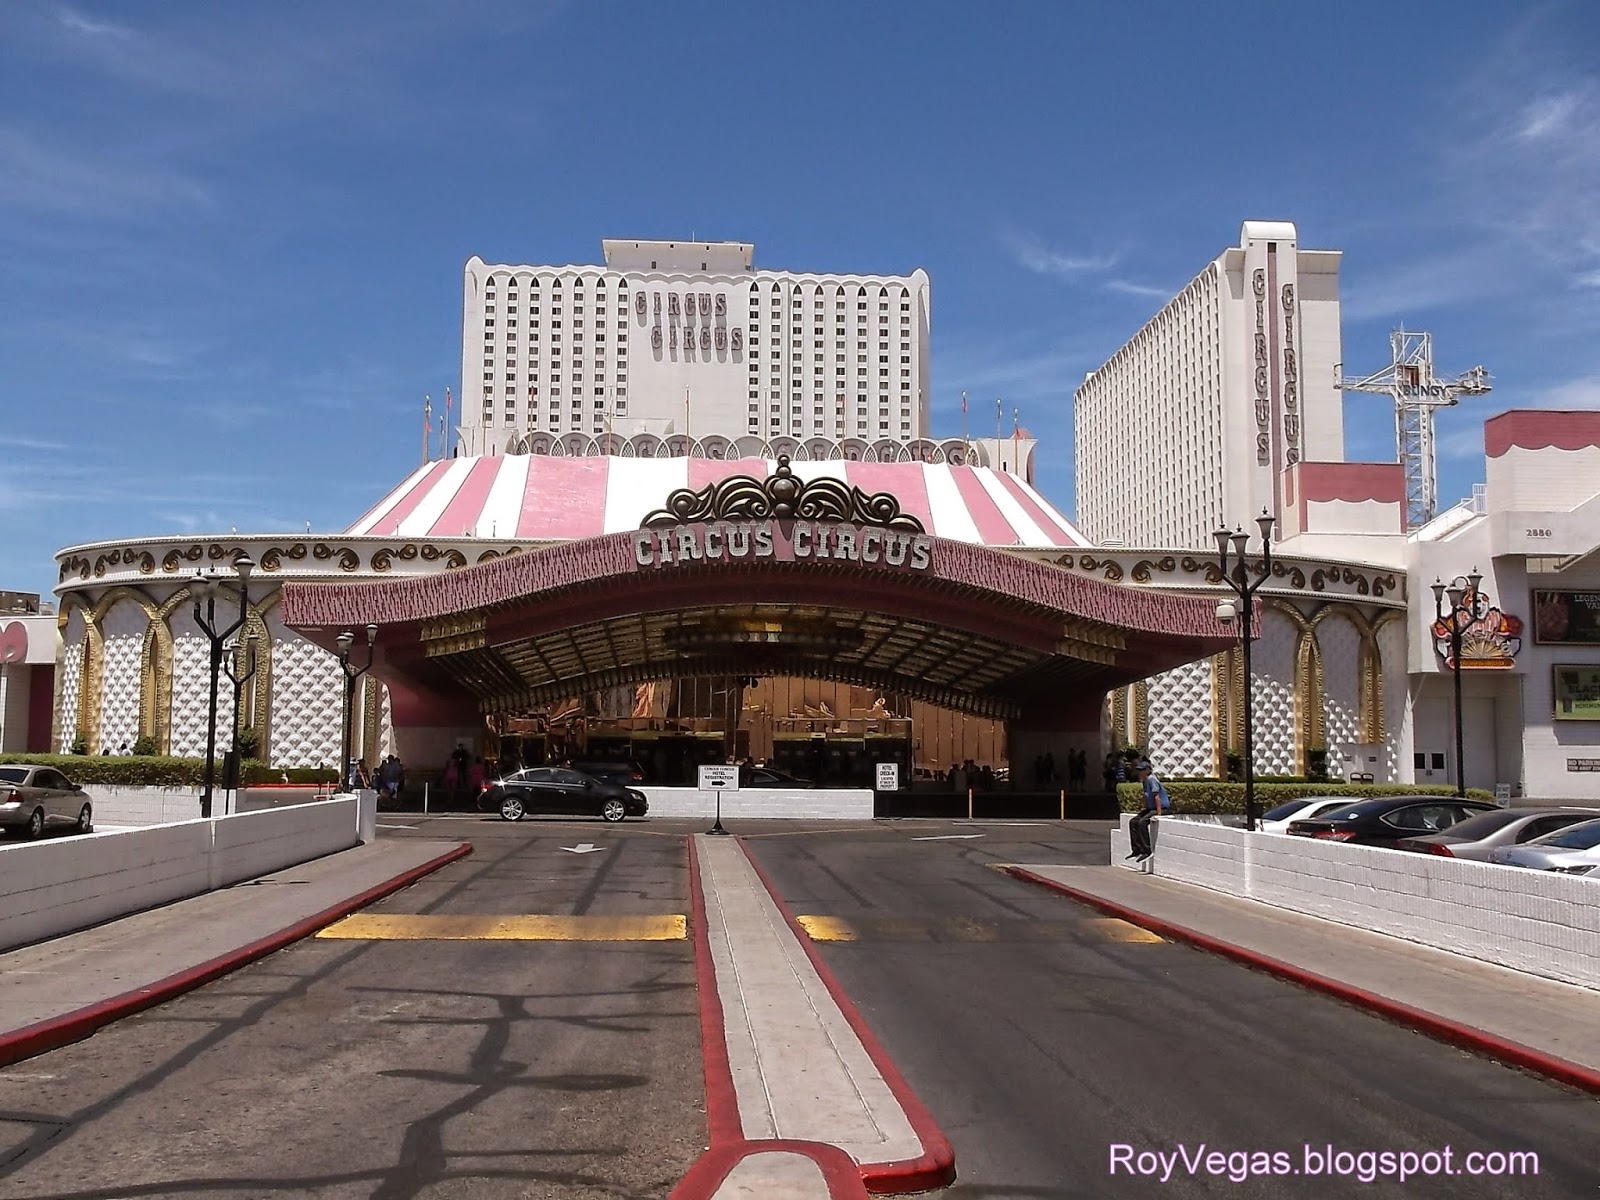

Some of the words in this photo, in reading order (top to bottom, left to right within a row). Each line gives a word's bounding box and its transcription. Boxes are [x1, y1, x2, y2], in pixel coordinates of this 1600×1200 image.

[635, 291, 727, 316] CIRCUS
[651, 326, 743, 350] CIRCUS
[1252, 268, 1270, 466] CIRCUS
[1526, 529, 1552, 537] 2880
[634, 524, 774, 566] CIRCUS
[793, 523, 932, 570] CIRCUS
